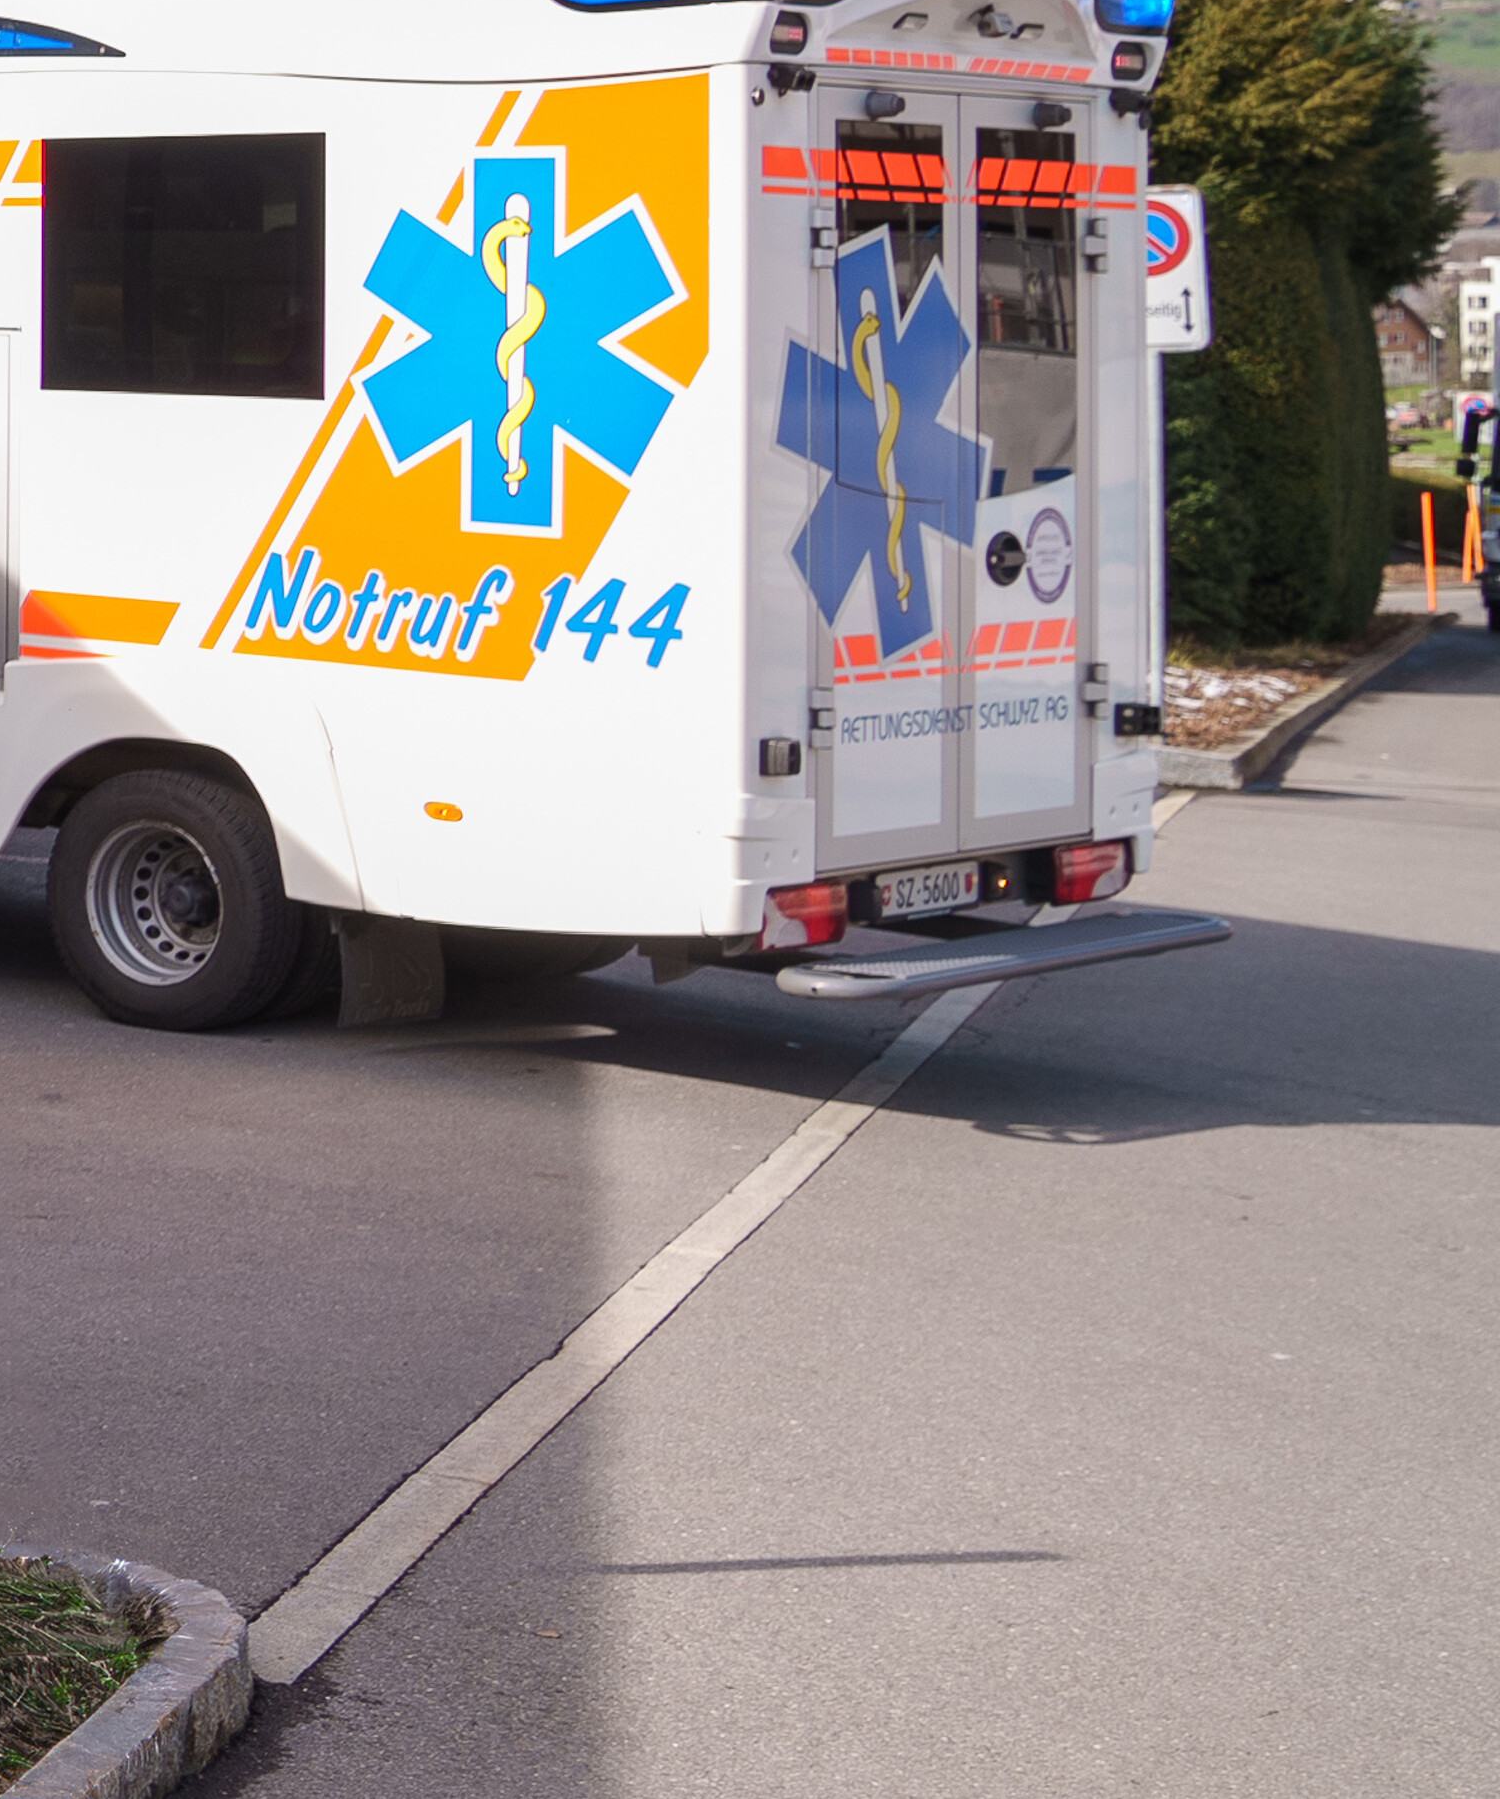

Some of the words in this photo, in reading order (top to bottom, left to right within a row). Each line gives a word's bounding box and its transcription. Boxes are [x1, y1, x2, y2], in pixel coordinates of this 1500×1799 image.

[1146, 301, 1182, 322] seitig
[244, 548, 510, 655] Notruf
[533, 576, 692, 669] 144
[840, 704, 974, 745] RETTUNGSDIENST
[978, 697, 1040, 730] SCHWYZ
[1044, 694, 1070, 722] AG
